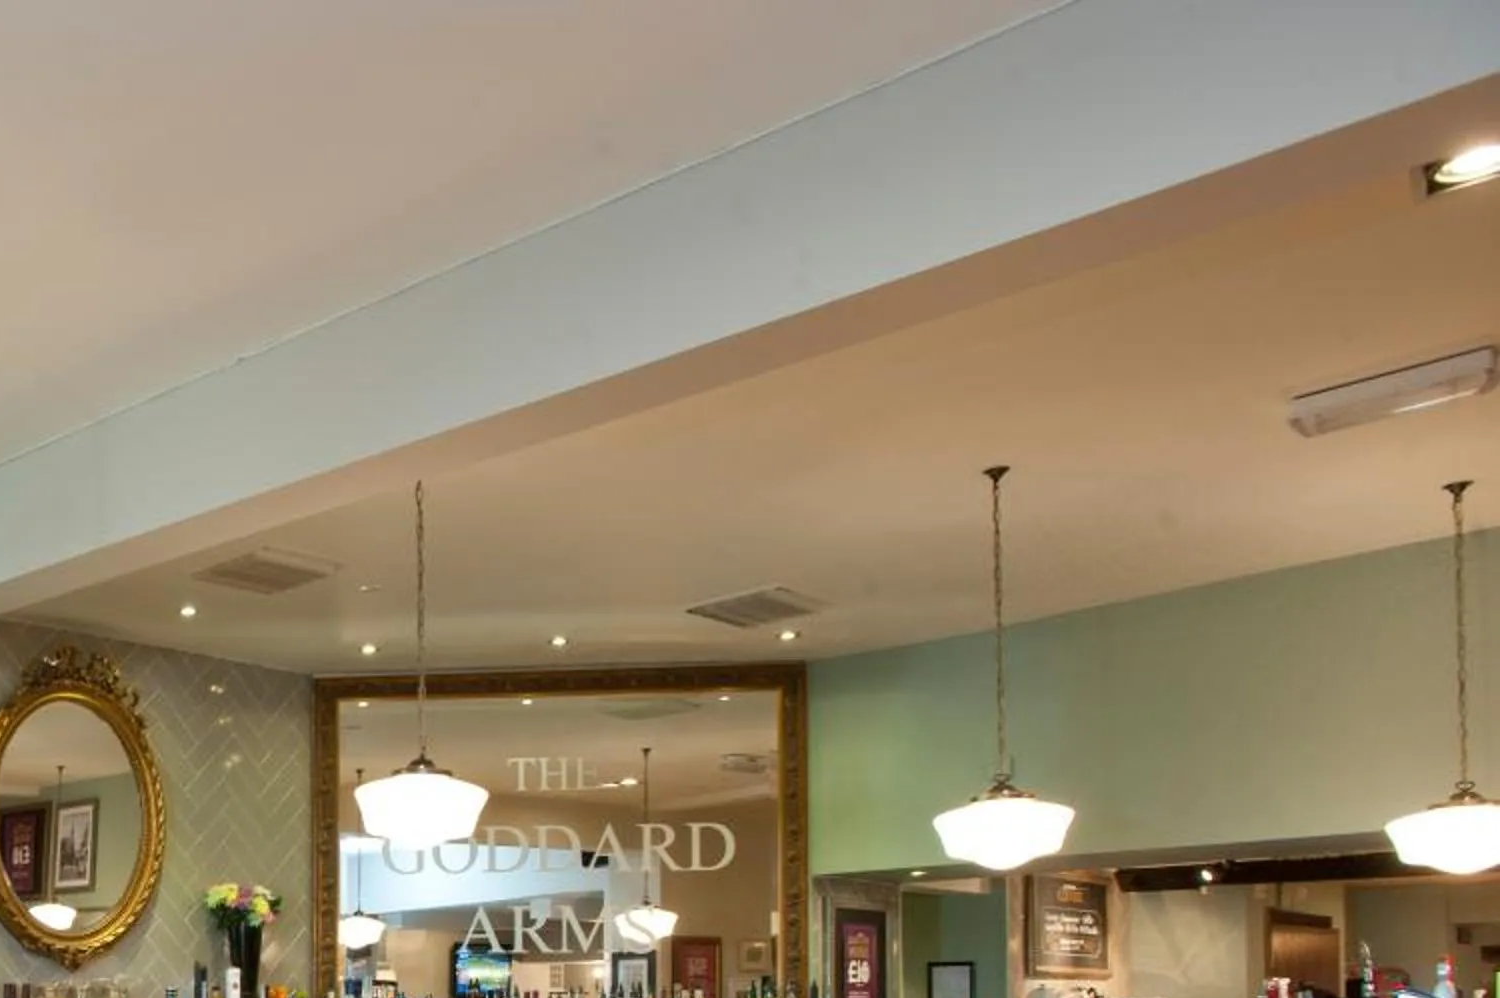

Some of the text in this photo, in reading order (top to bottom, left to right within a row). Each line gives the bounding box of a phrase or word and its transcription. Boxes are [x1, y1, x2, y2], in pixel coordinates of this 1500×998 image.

[507, 757, 599, 791] THE
[381, 822, 736, 875] GODDARD
[461, 905, 658, 955] ARMS
